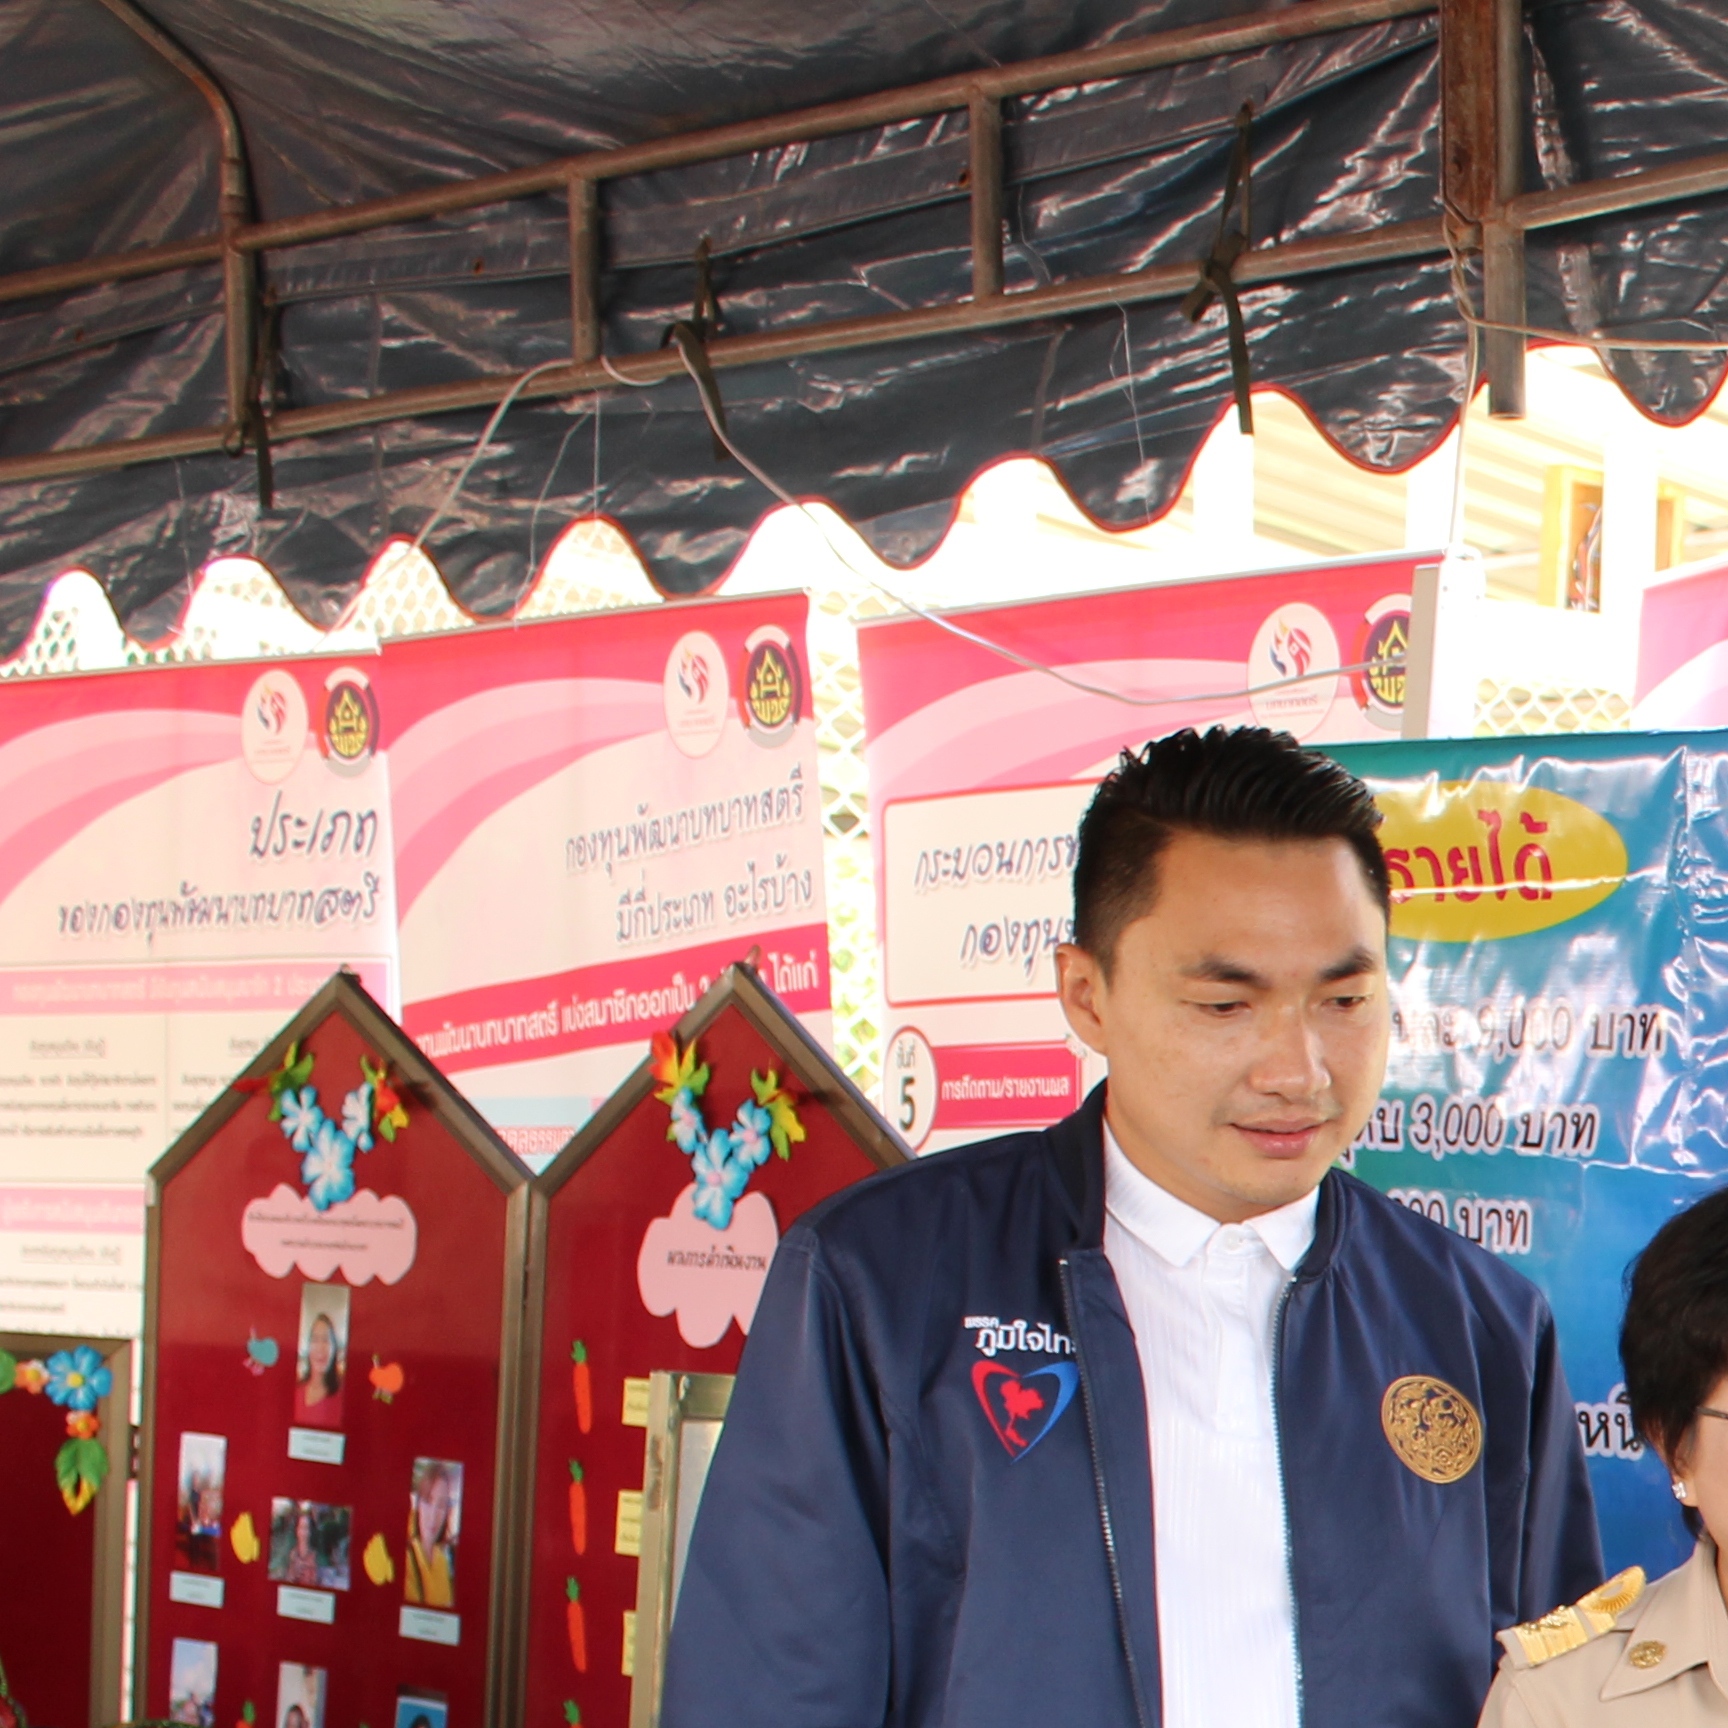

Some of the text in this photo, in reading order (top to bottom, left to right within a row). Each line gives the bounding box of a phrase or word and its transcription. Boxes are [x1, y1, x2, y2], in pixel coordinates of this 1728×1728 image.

[251, 789, 378, 858] ประเภท
[564, 763, 804, 880] กองทุนพัฒนาบทบาทสตรี
[724, 853, 813, 919] อะไรบ้าง
[899, 1077, 917, 1133] 5
[1413, 1101, 1505, 1153] 3,000
[1518, 1108, 1597, 1153] บาท
[1459, 1204, 1530, 1248] บาท
[974, 1318, 1077, 1358] ภูมิใจไท
